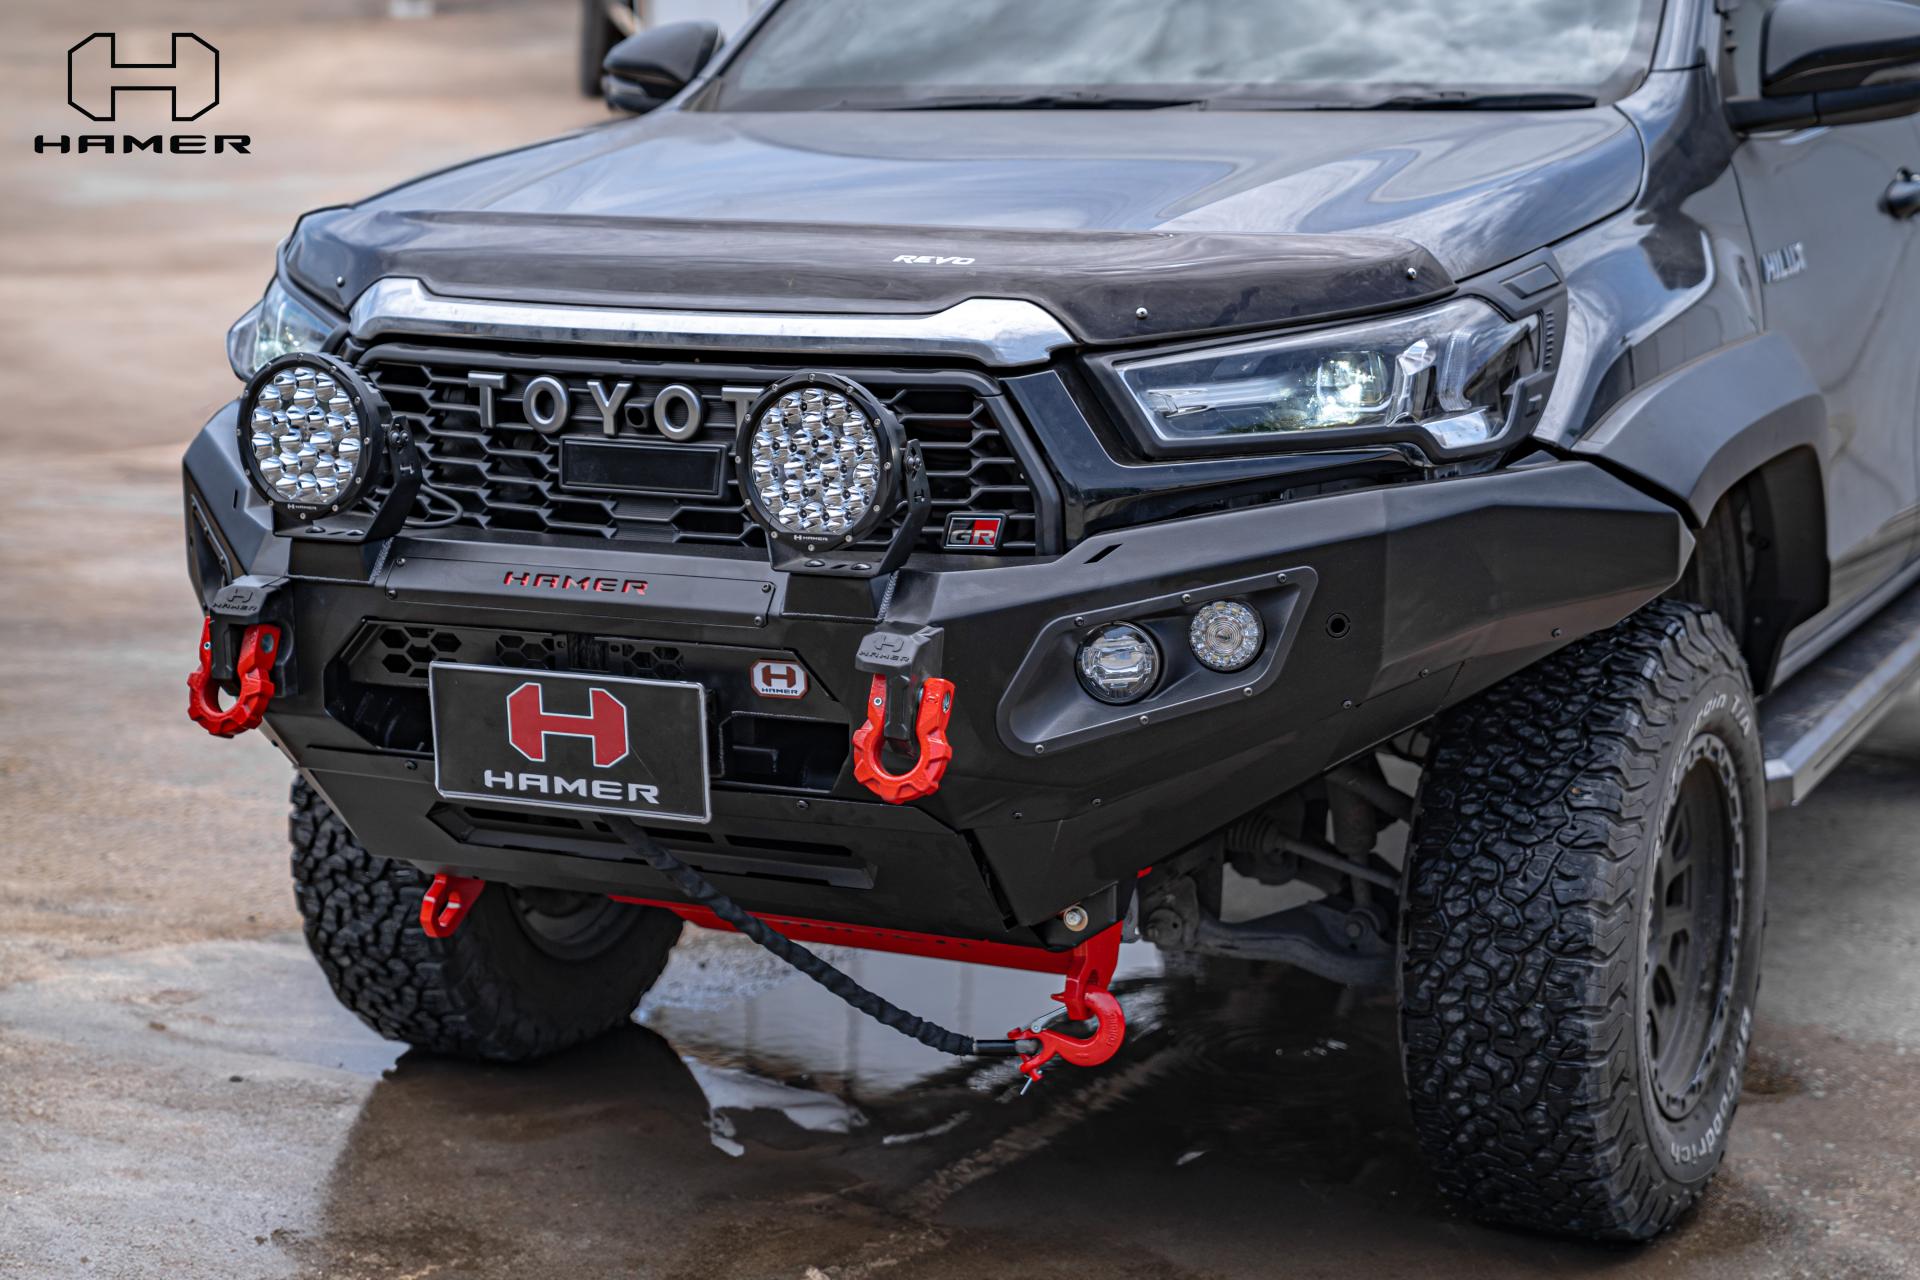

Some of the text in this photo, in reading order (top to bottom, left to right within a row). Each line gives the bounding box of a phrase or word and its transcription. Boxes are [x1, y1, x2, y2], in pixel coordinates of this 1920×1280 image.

[892, 254, 975, 265] REVO
[468, 371, 766, 442] TOYOT
[949, 529, 995, 545] GR
[503, 571, 649, 596] HAMER
[761, 687, 799, 695] HAMER
[484, 769, 660, 805] HAMER
